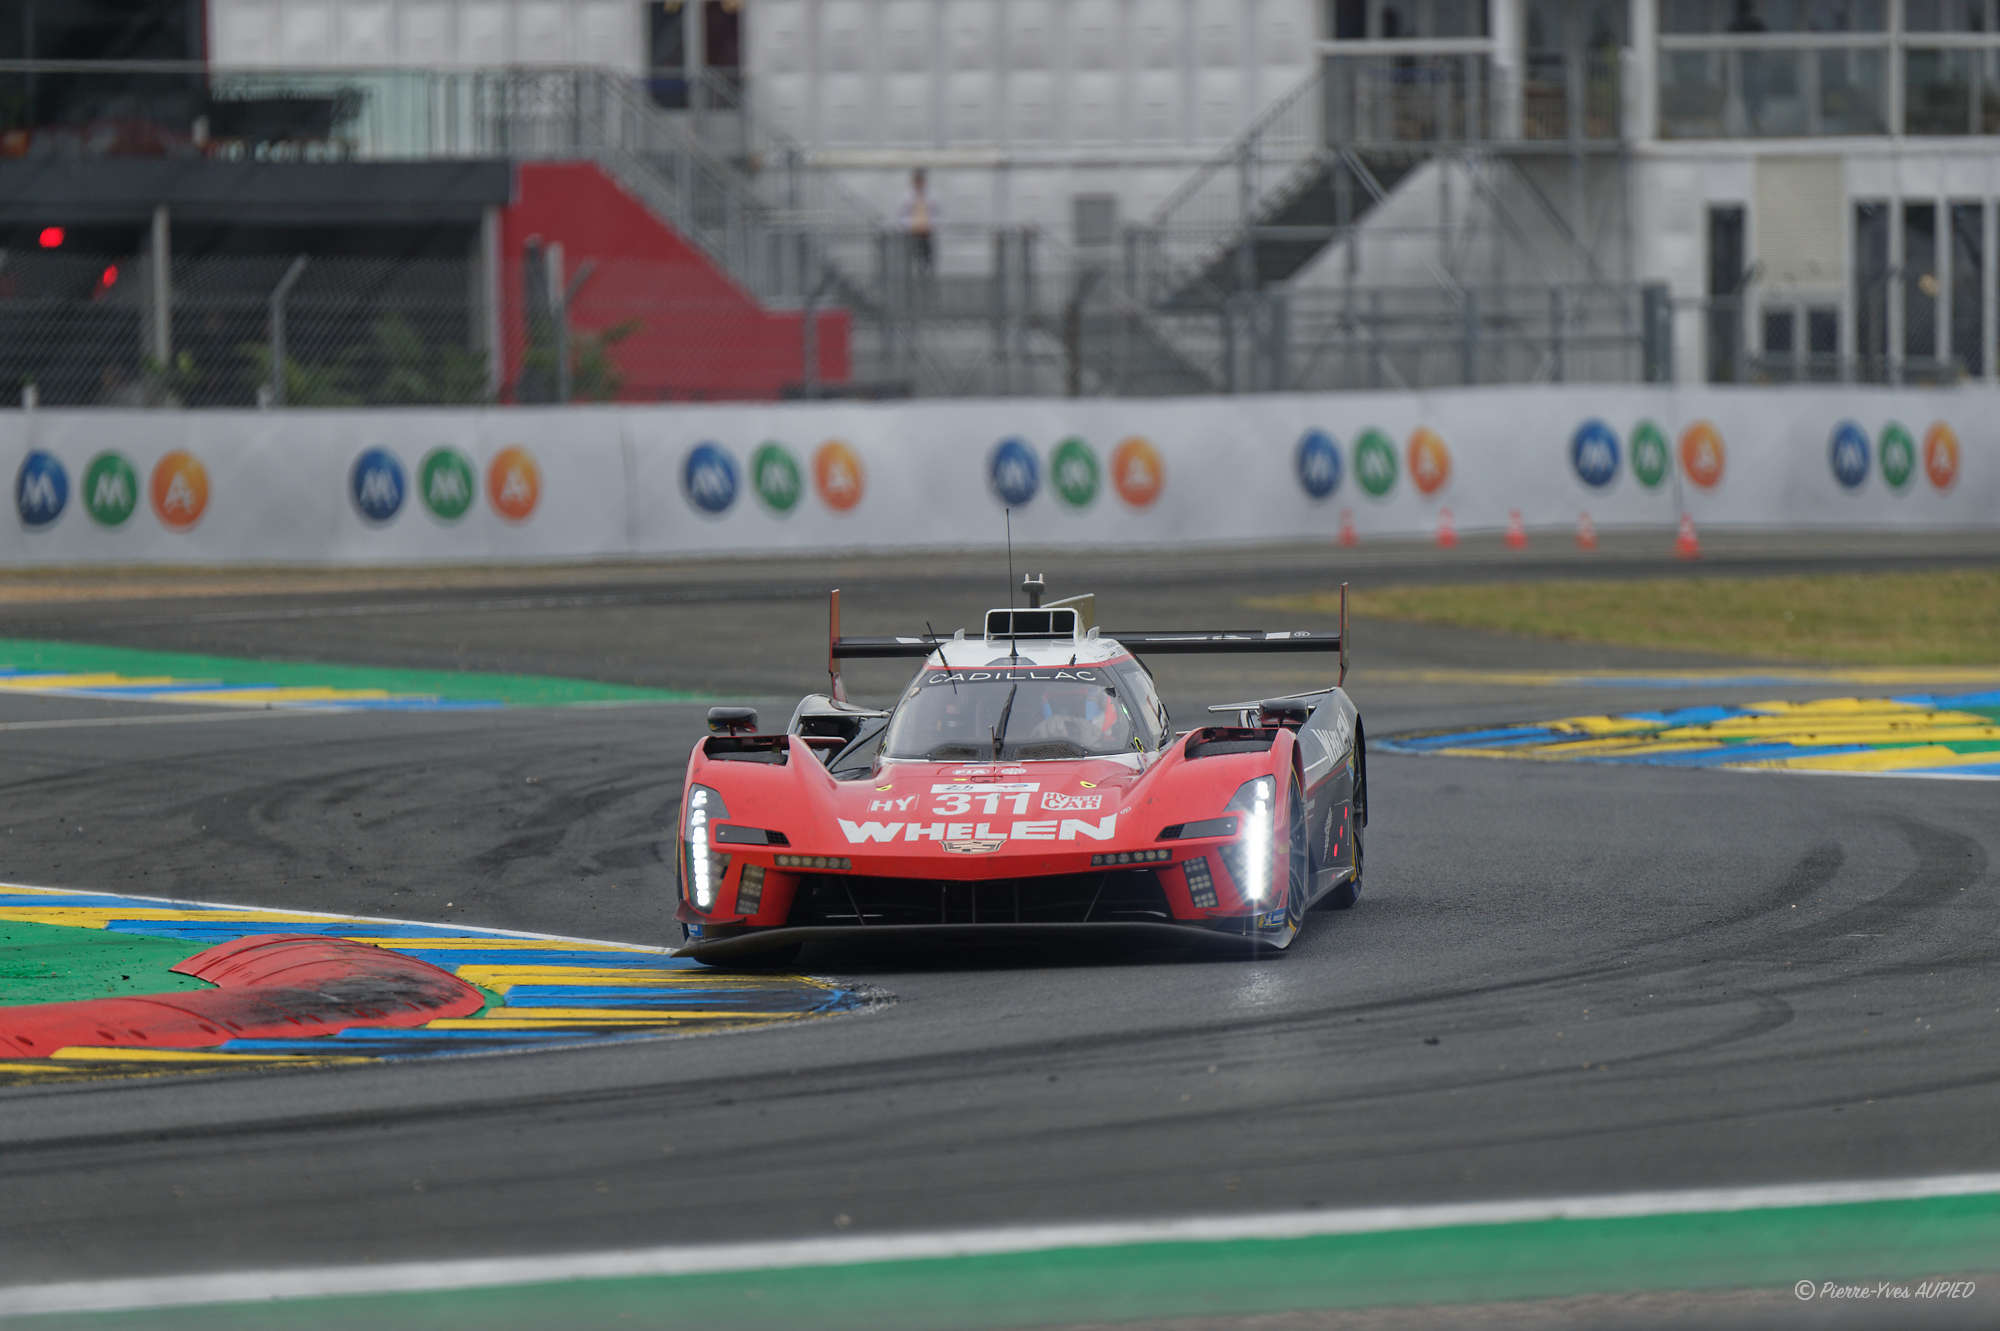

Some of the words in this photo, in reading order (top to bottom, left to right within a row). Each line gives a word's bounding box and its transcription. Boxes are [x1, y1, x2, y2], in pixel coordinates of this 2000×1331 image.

[928, 670, 1097, 685] CADILLAC
[870, 795, 915, 812] HY
[932, 793, 1031, 815] 311
[1043, 798, 1099, 809] CAR
[837, 813, 1118, 843] WHELEN
